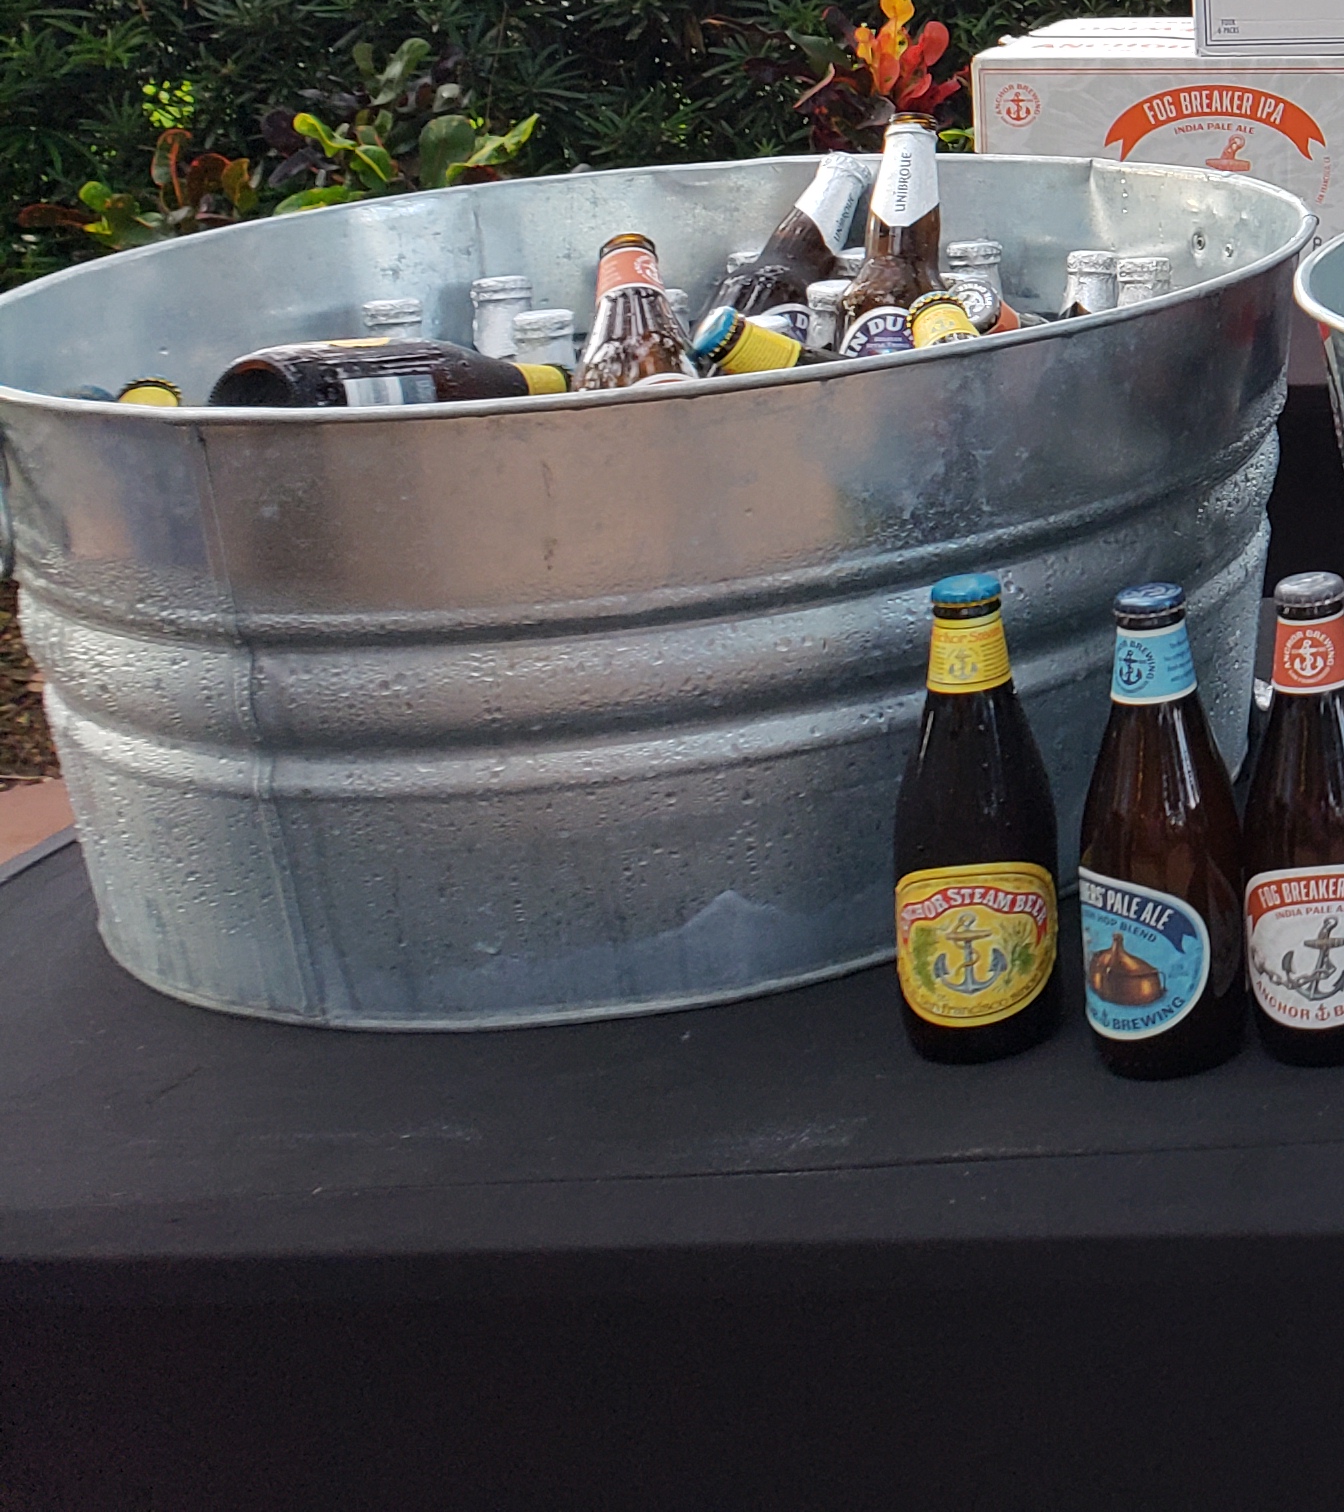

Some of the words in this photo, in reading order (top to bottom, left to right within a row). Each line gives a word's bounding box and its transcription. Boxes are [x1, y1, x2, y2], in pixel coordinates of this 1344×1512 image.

[995, 84, 1014, 116] ANCHOR
[1016, 83, 1042, 116] BREWING
[1143, 95, 1176, 124] FOG
[1179, 90, 1253, 116] BREAKER
[1256, 95, 1285, 125] IPA
[1174, 123, 1204, 135] INDIA
[1207, 123, 1233, 131] PALE
[1236, 124, 1255, 135] ALE
[893, 152, 912, 212] UNIBROUE
[867, 316, 904, 336] DU
[1130, 640, 1155, 680] BREWING
[1283, 631, 1304, 668] ANCHOR
[1306, 629, 1335, 666] BREWING
[947, 889, 1011, 912] STEAM
[1106, 890, 1141, 919] PALE
[1140, 902, 1174, 930] ALE
[1258, 884, 1281, 909] FOG
[1281, 878, 1344, 903] BREAKER
[1275, 908, 1303, 919] INDIA
[1305, 905, 1333, 914] PALE
[1119, 921, 1157, 943] BLEND
[1112, 996, 1185, 1031] BREWING
[1256, 980, 1310, 1021] ANCHOR
